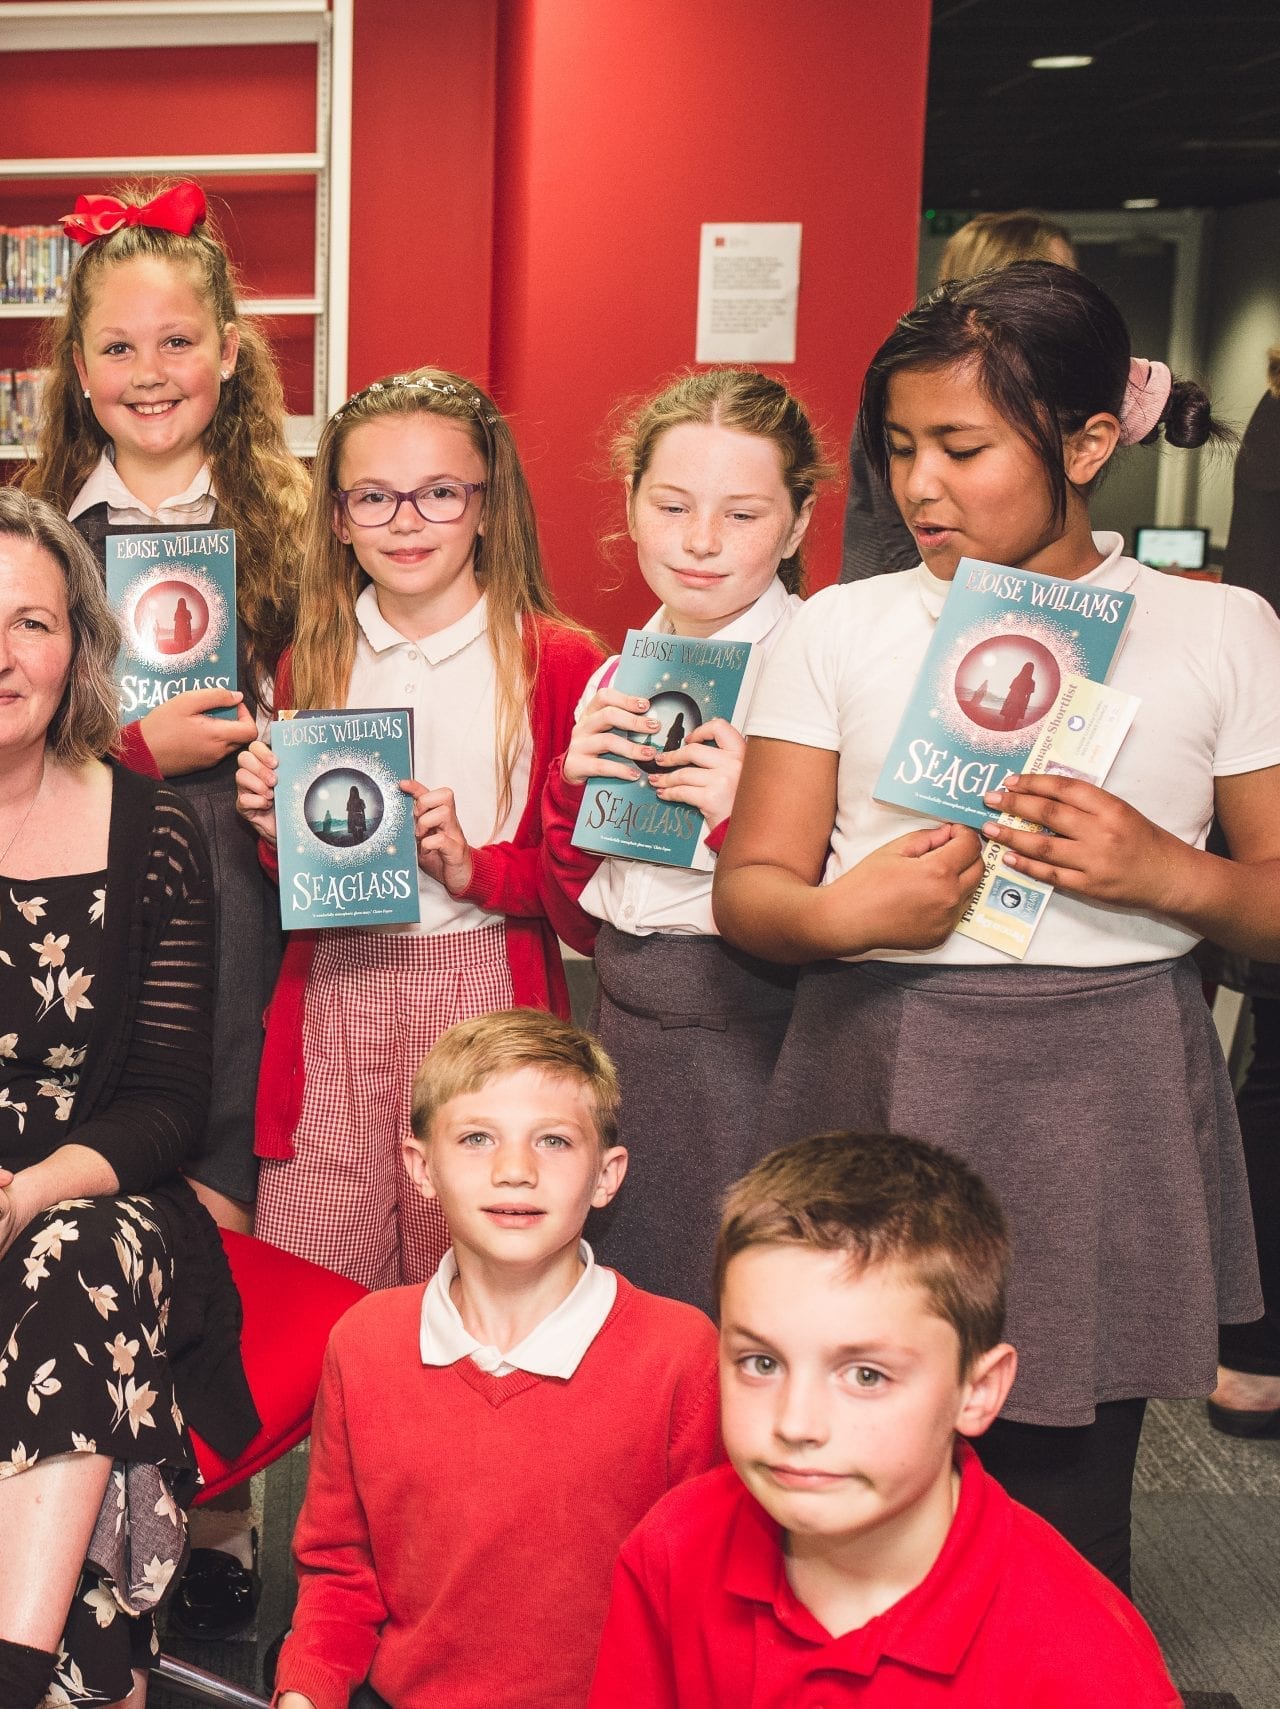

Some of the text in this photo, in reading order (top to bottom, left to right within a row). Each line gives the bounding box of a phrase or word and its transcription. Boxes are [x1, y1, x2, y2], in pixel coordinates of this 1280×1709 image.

[117, 533, 229, 559] ELOISE WILLIAMS
[965, 569, 1124, 624] ELOISE WILLIAMS
[631, 636, 745, 670] ELOISE WILLIAMS
[282, 717, 403, 746] ELOISE WILLIAMS
[1027, 681, 1079, 775] nguage Shortlist
[893, 739, 1017, 800] SEAGLA
[584, 789, 699, 840] SEAGLASS
[292, 869, 411, 911] SEAGLASS
